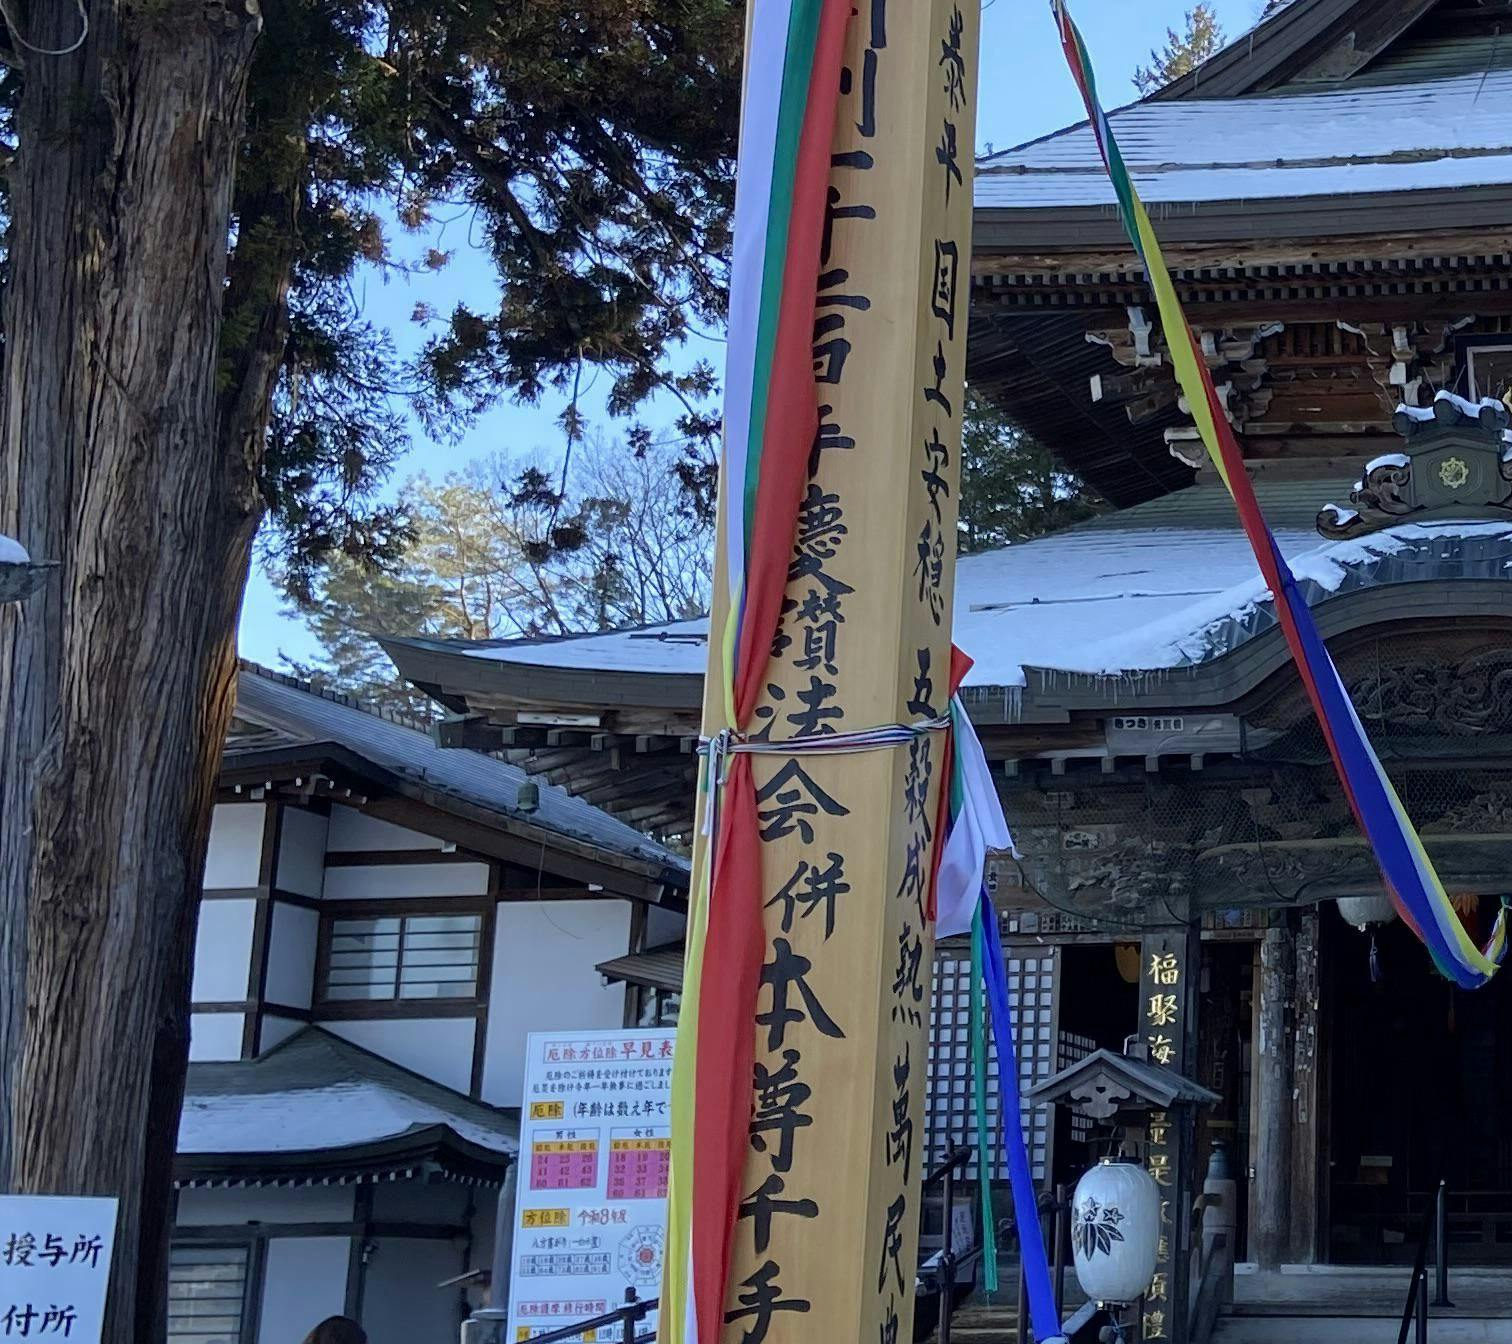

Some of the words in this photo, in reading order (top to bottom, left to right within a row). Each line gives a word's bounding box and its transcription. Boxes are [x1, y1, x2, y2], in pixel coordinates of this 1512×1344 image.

[555, 1131, 577, 1140] 男性
[633, 1128, 654, 1138] 女性
[525, 1210, 568, 1225] 方位除
